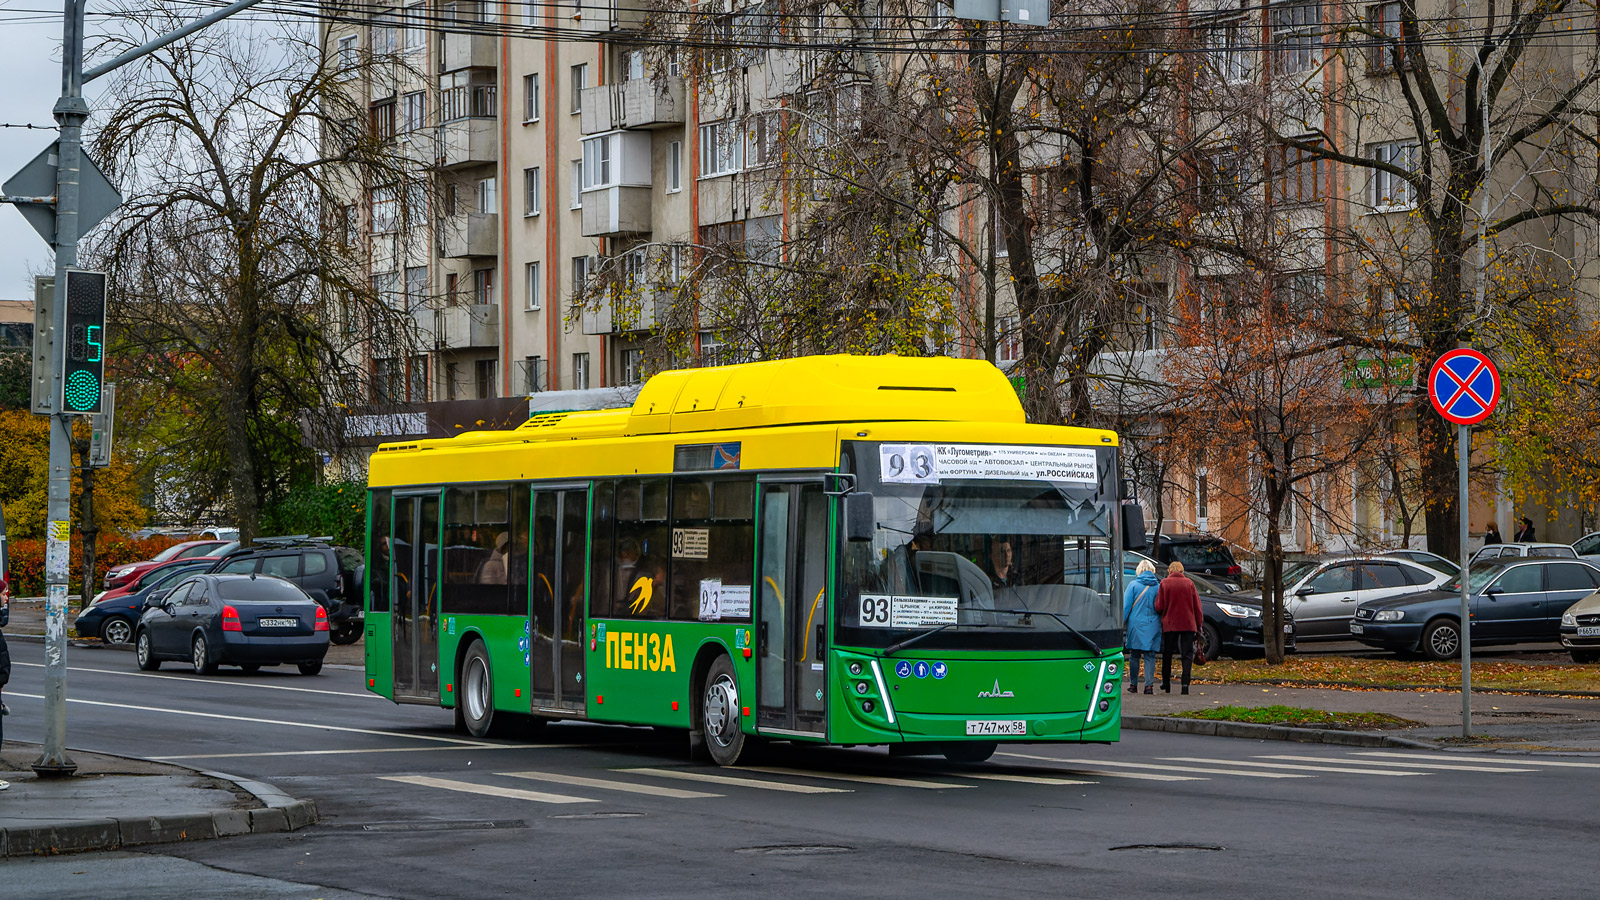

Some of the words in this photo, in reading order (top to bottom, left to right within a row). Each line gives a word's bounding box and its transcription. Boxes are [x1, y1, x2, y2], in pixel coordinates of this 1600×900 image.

[87, 325, 101, 362] 5
[984, 459, 1025, 467] АВТОВОКЗАЛ
[1030, 460, 1073, 468] ЦЕНТРАЛЬНЫЙ
[984, 469, 1020, 477] ДИЗЕЛЬНЫЙ
[1036, 469, 1095, 480] ул.РОССИЙСКАЯ
[673, 531, 684, 554] 93
[862, 598, 889, 623] 93
[606, 631, 676, 673] ПЕНЗА
[1012, 721, 1023, 730] 58
